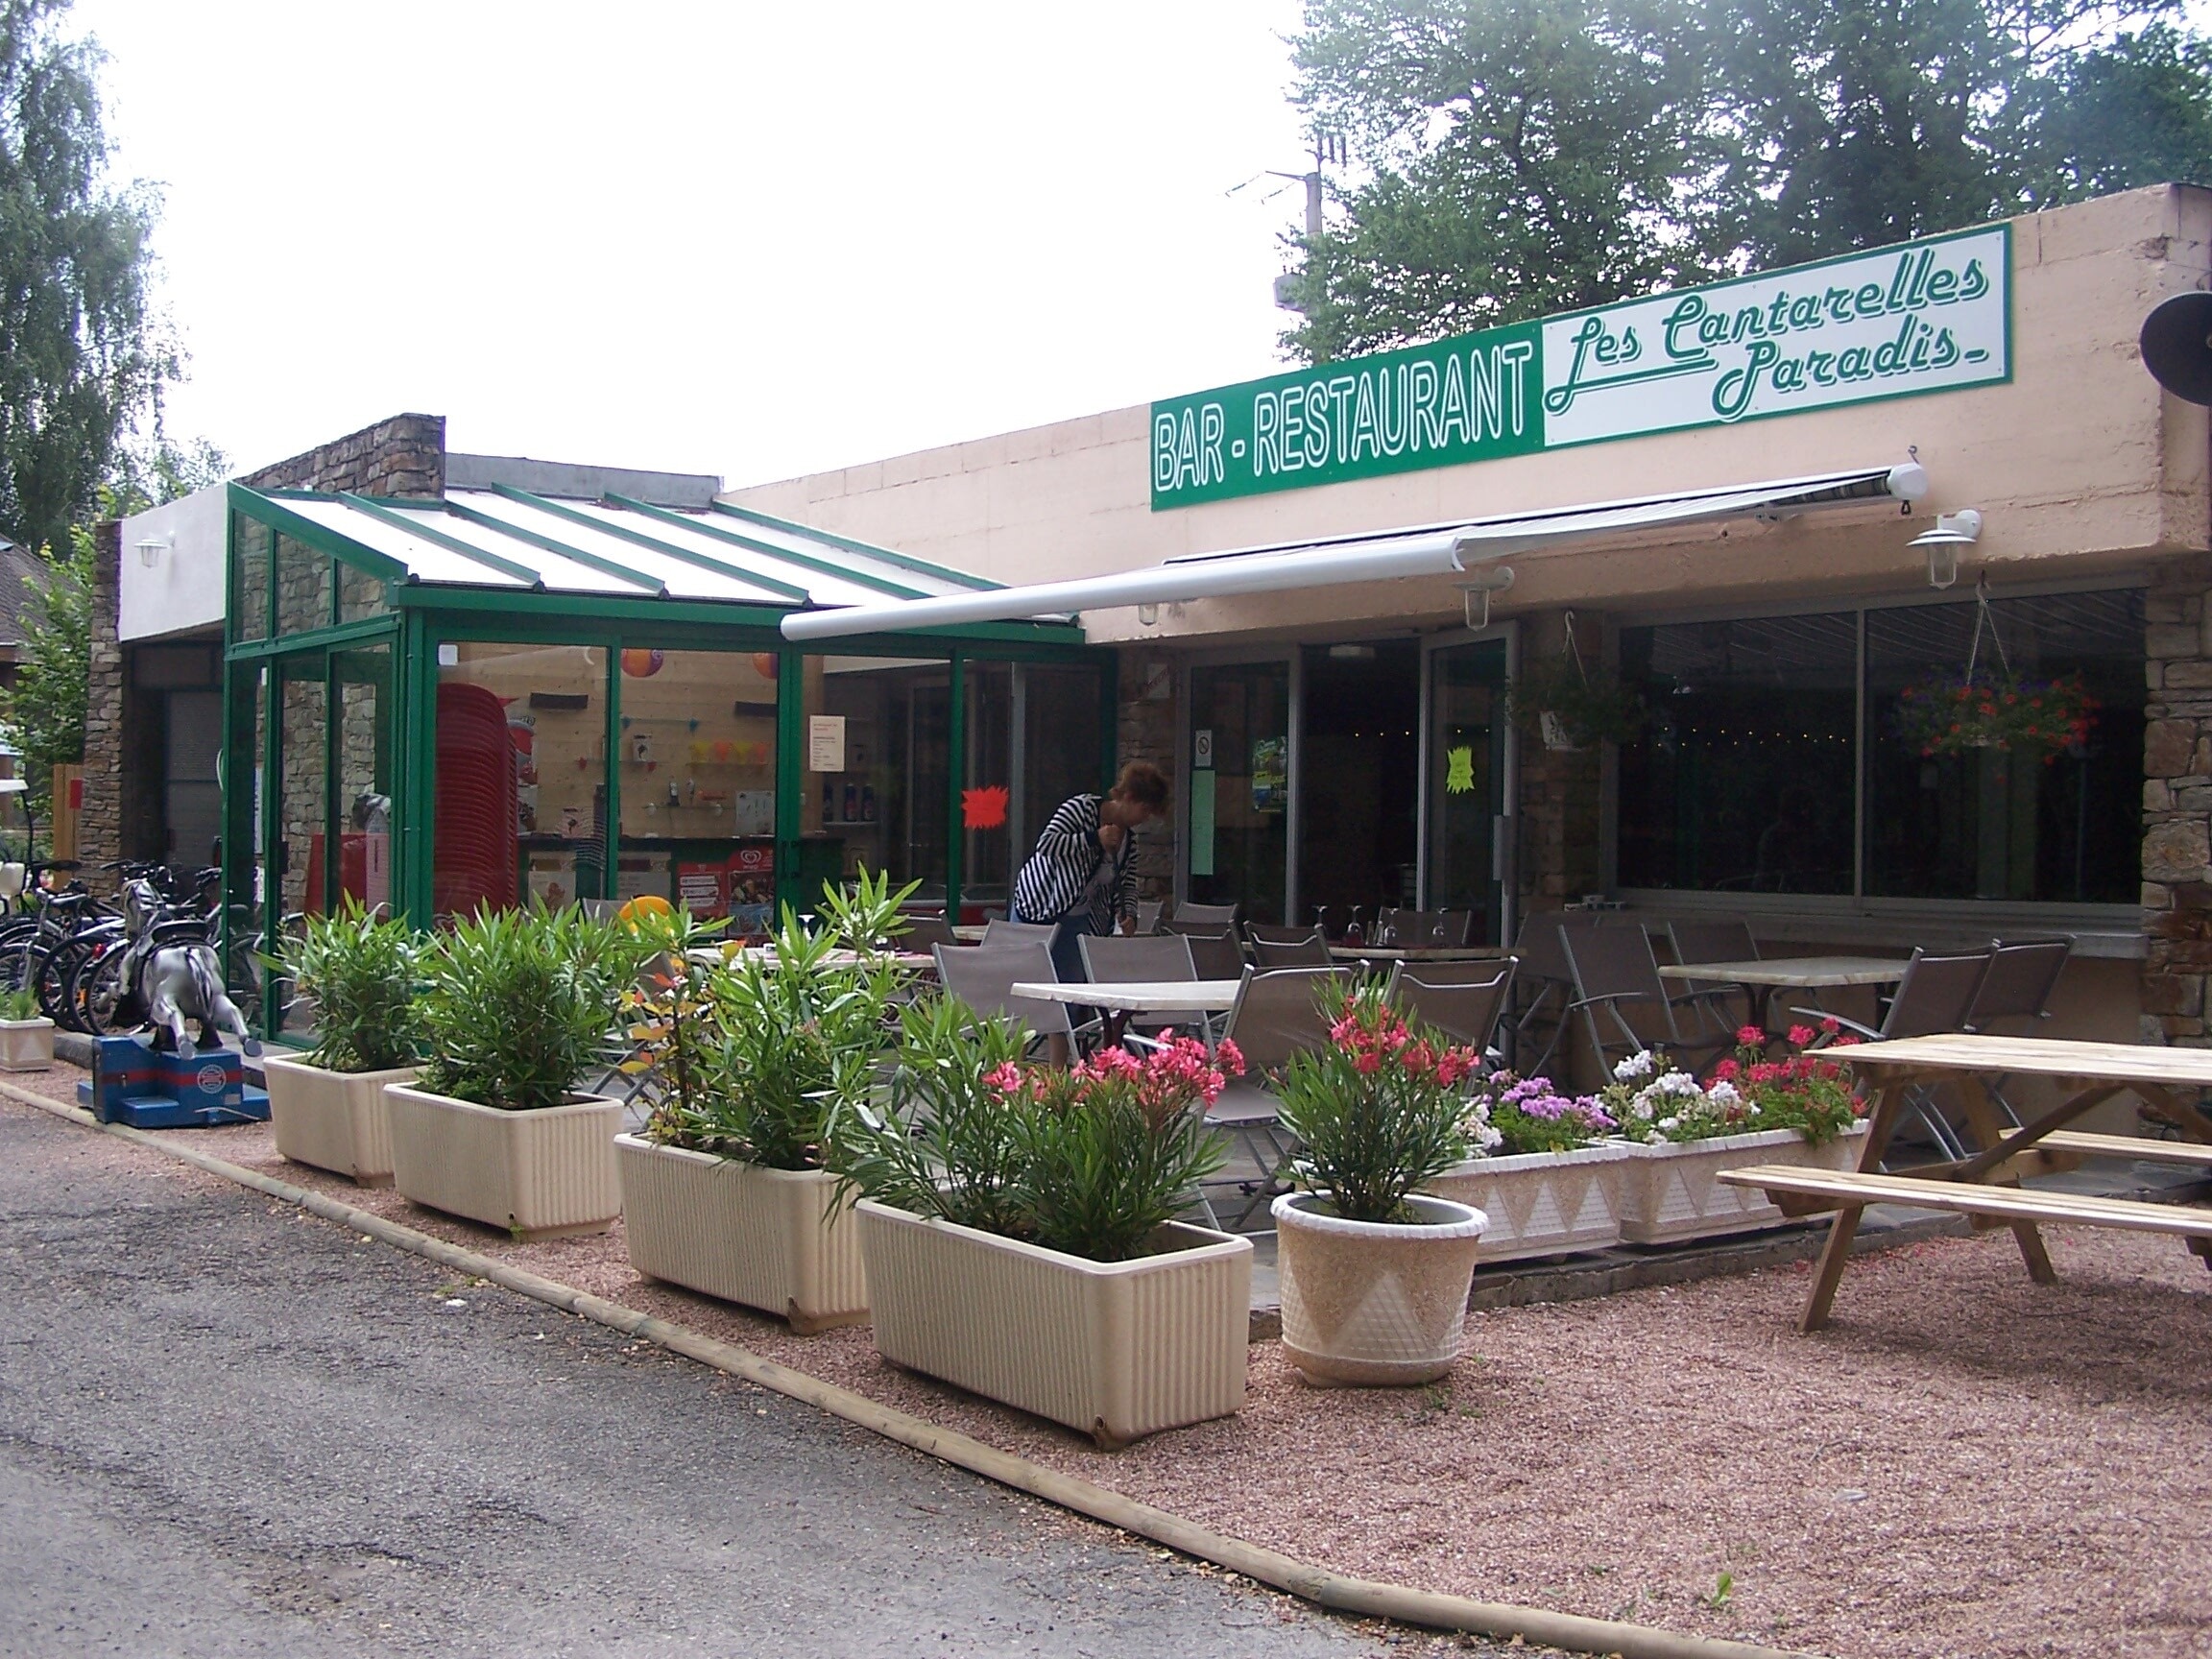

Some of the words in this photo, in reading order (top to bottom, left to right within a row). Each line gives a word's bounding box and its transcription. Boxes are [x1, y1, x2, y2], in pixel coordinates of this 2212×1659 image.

[1545, 316, 1642, 417] Les
[1662, 247, 1989, 363] Cantarelles
[1155, 403, 1224, 492] BAR
[1253, 340, 1532, 477] RESTAURANT
